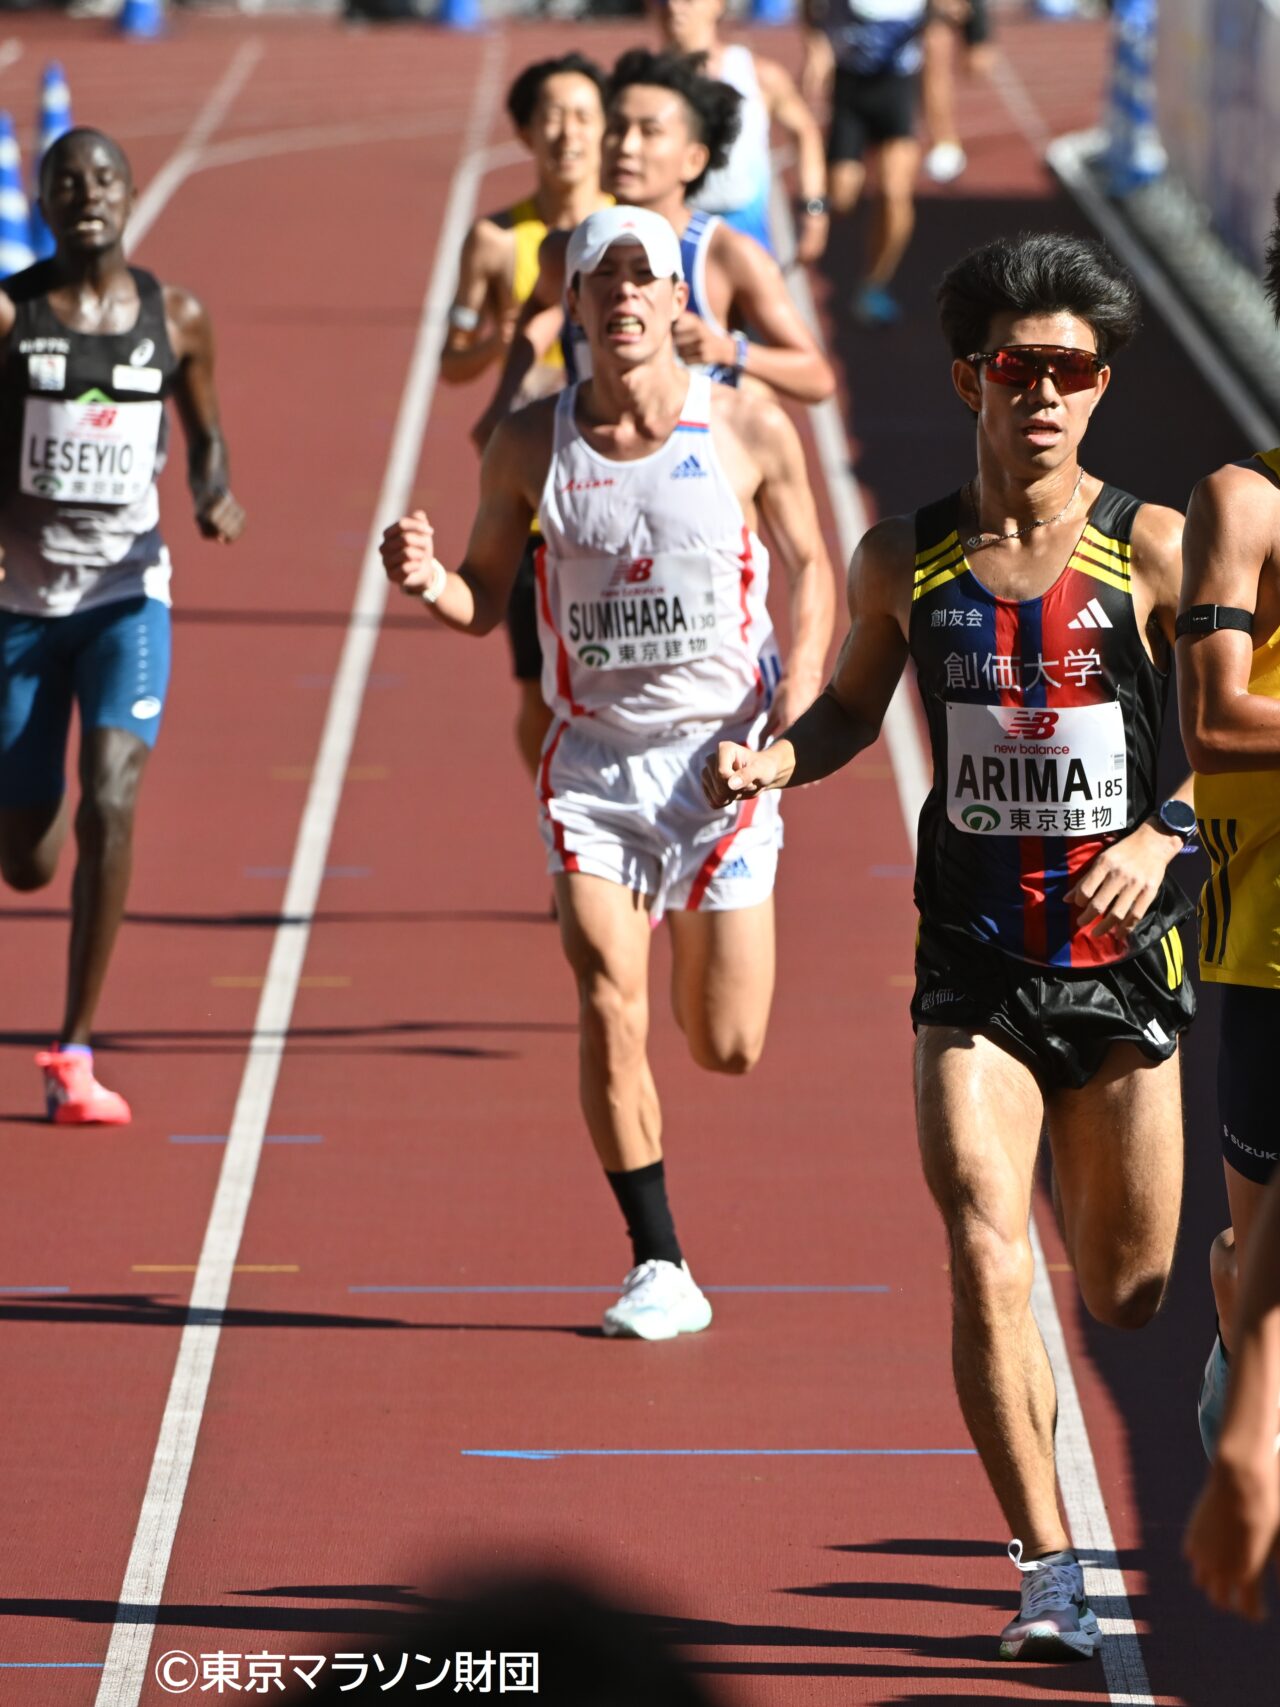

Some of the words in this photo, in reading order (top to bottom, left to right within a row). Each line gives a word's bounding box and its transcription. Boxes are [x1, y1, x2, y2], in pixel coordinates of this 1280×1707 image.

[29, 434, 134, 476] LESEYIO
[569, 596, 688, 643] SUMIHARA
[931, 608, 983, 628] 創友会
[617, 638, 707, 664] 東京建物
[944, 648, 1102, 692] 創価大学
[994, 744, 1017, 754] new
[1019, 743, 1070, 755] balance
[954, 754, 1093, 803] ARIMA
[1098, 778, 1123, 799] 185
[1009, 805, 1112, 832] 東京建物
